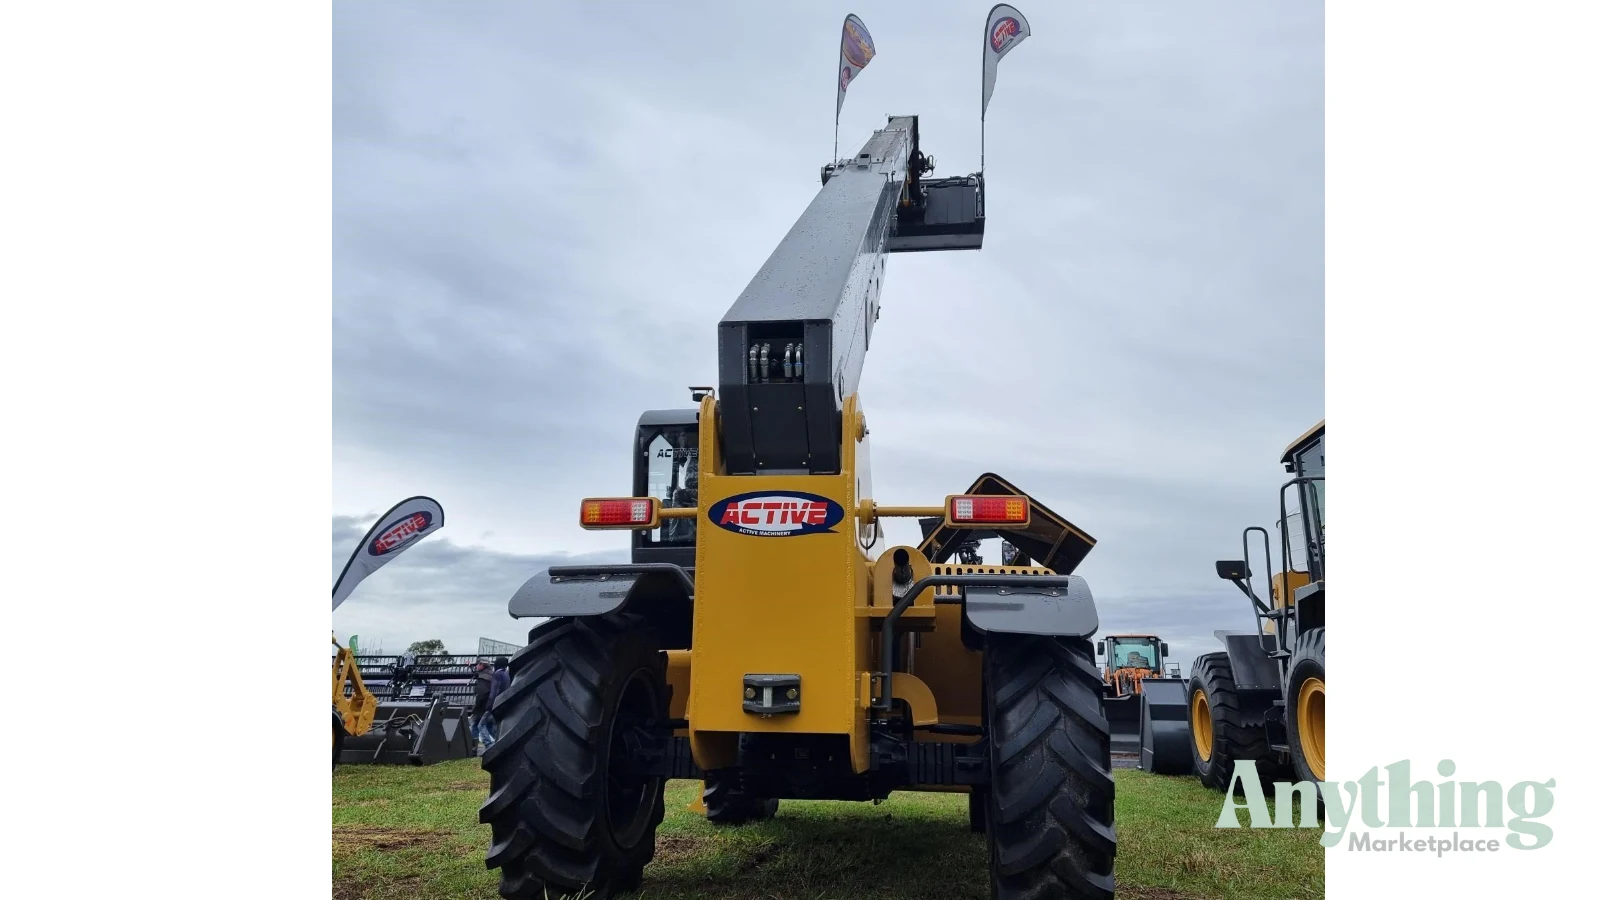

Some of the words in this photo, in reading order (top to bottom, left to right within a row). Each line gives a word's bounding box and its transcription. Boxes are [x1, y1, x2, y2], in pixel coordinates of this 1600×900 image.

[656, 447, 698, 458] ACTIVE
[720, 502, 828, 525] ACTIVE
[375, 513, 426, 554] ACTIVE
[739, 527, 759, 536] ACTIVE
